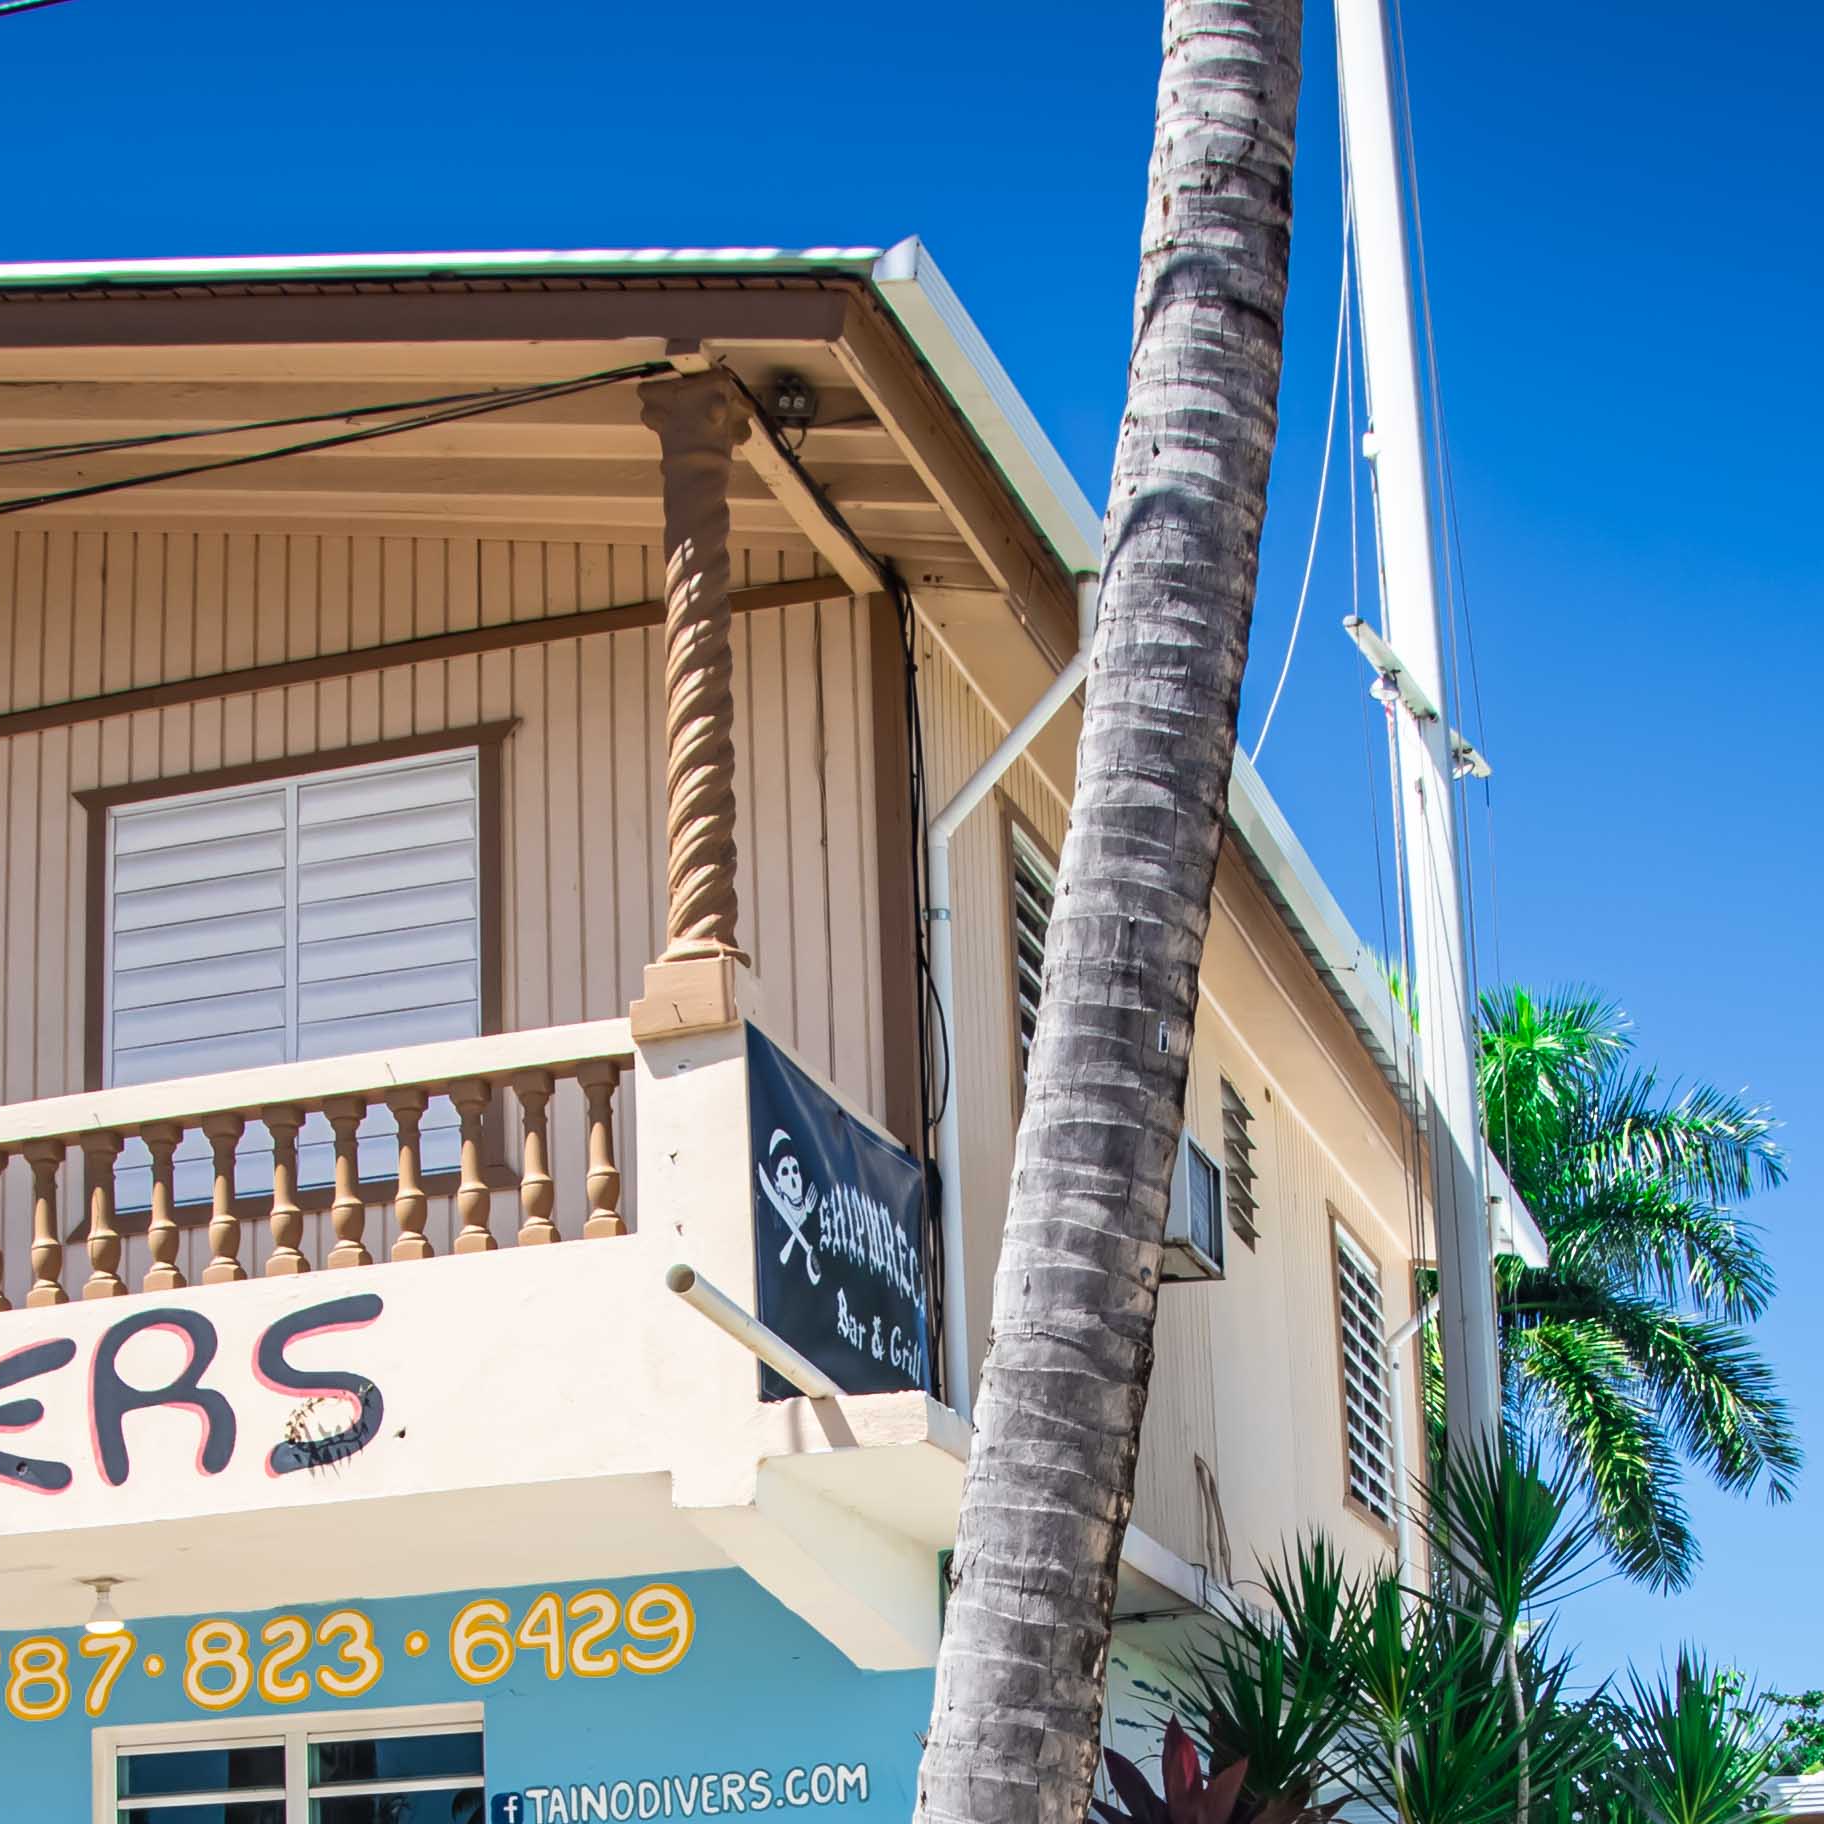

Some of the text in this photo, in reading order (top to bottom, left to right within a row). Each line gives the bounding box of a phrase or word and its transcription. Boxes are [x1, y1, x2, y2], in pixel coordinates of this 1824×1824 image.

[837, 1288, 922, 1386] Bar & Grill
